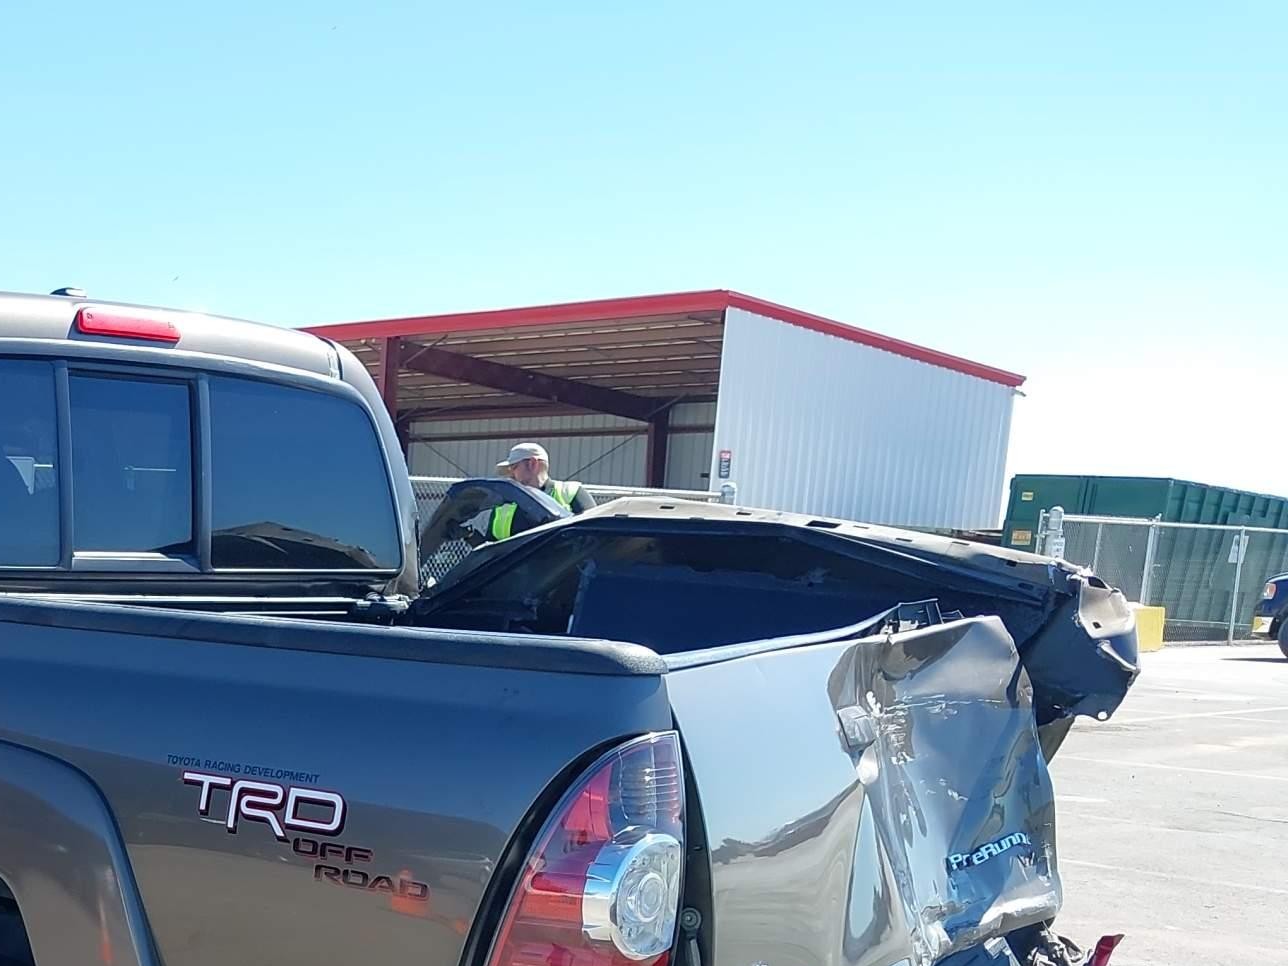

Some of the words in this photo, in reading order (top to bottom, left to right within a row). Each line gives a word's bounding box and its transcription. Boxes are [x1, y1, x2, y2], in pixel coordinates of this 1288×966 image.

[167, 754, 201, 768] TOYOTA
[204, 759, 241, 774] RACING
[243, 765, 321, 784] DEVELOPMENT
[183, 771, 347, 843] TRD
[292, 838, 374, 864] OFF
[948, 832, 1032, 870] PreRunn
[314, 864, 431, 899] ROAD
